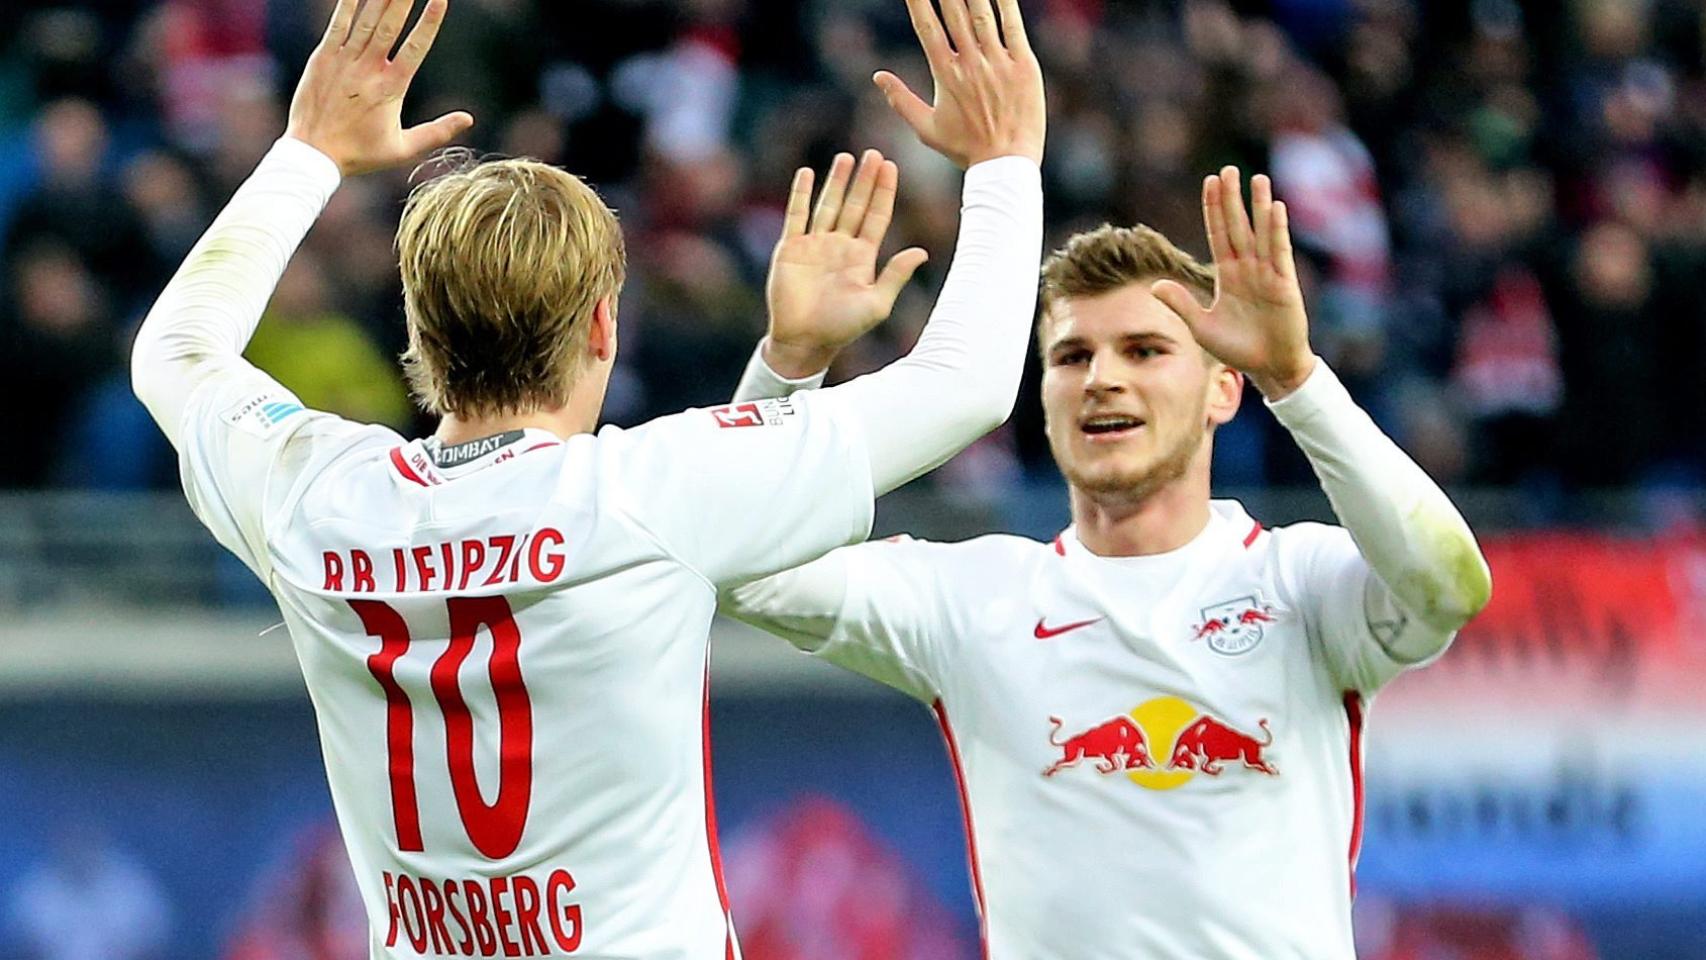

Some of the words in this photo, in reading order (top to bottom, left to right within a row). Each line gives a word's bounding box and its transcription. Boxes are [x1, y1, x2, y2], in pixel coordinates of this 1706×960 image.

[323, 549, 375, 592] RB
[345, 595, 533, 860] 10
[383, 869, 583, 957] FORSBERG
